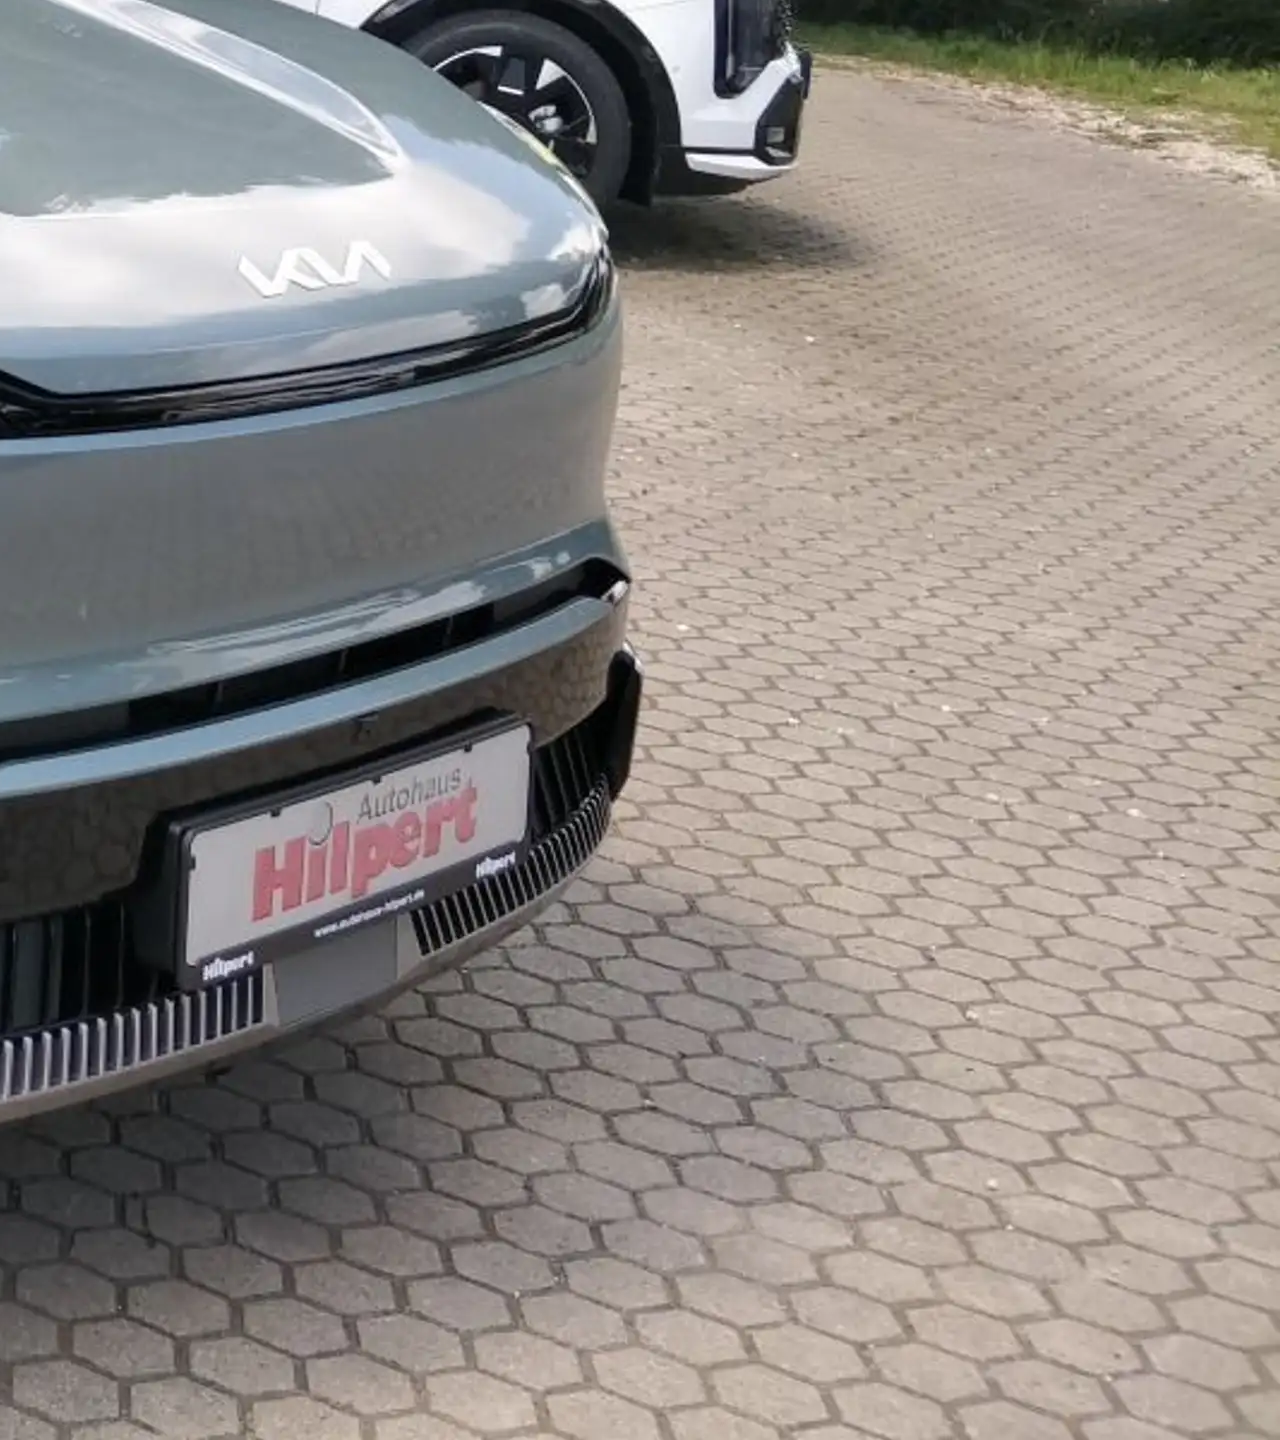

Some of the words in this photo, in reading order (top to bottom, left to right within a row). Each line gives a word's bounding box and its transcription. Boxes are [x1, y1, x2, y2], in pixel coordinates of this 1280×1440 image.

[236, 239, 392, 299] KIA
[355, 765, 463, 824] Autohaus
[251, 778, 479, 922] Hilpert
[202, 949, 255, 980] Hilpert
